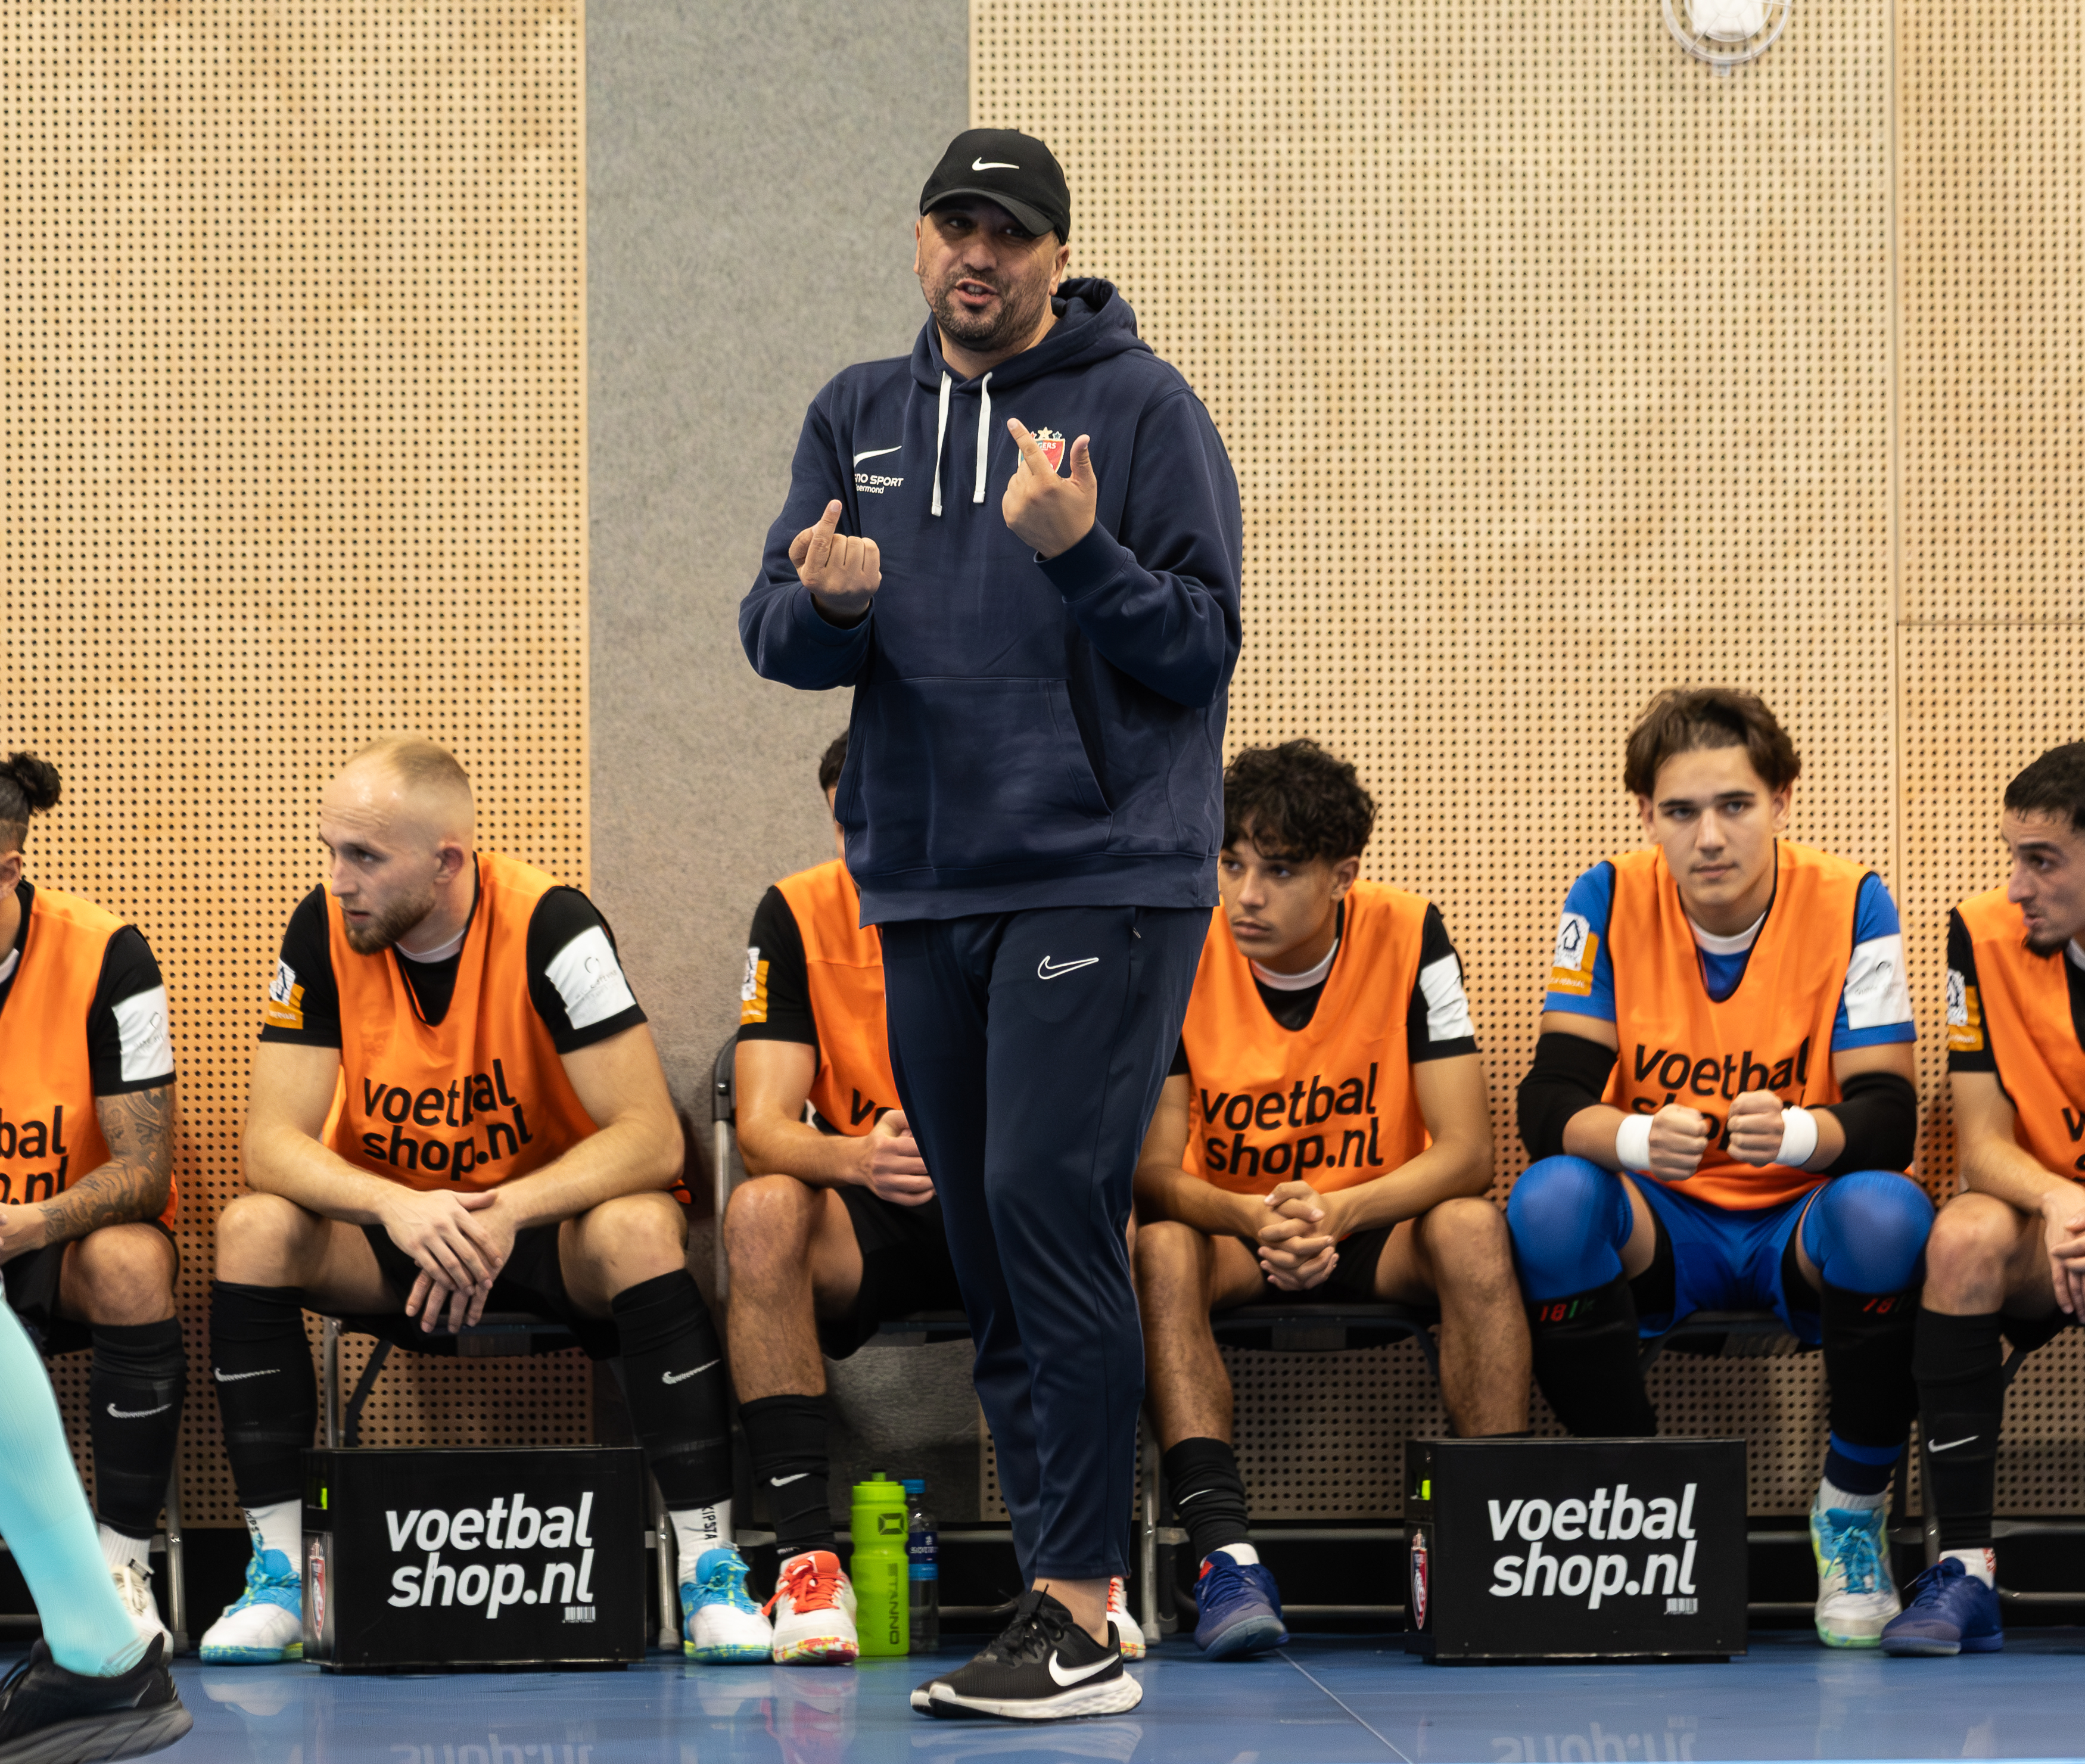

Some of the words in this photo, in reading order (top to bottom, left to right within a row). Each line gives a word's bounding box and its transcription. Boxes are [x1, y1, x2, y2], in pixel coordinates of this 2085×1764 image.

[855, 483, 885, 494] oermond
[870, 475, 904, 487] SPORT
[1200, 1062, 1377, 1131] voetbal
[1633, 1035, 1811, 1101] voetbal
[362, 1103, 533, 1181] shop.nl
[1205, 1116, 1383, 1181] shop.nl
[385, 1491, 594, 1552] voetbal
[1487, 1483, 1697, 1541] voetbal
[387, 1548, 595, 1619] shop.nl
[1489, 1539, 1698, 1610] shop.nl
